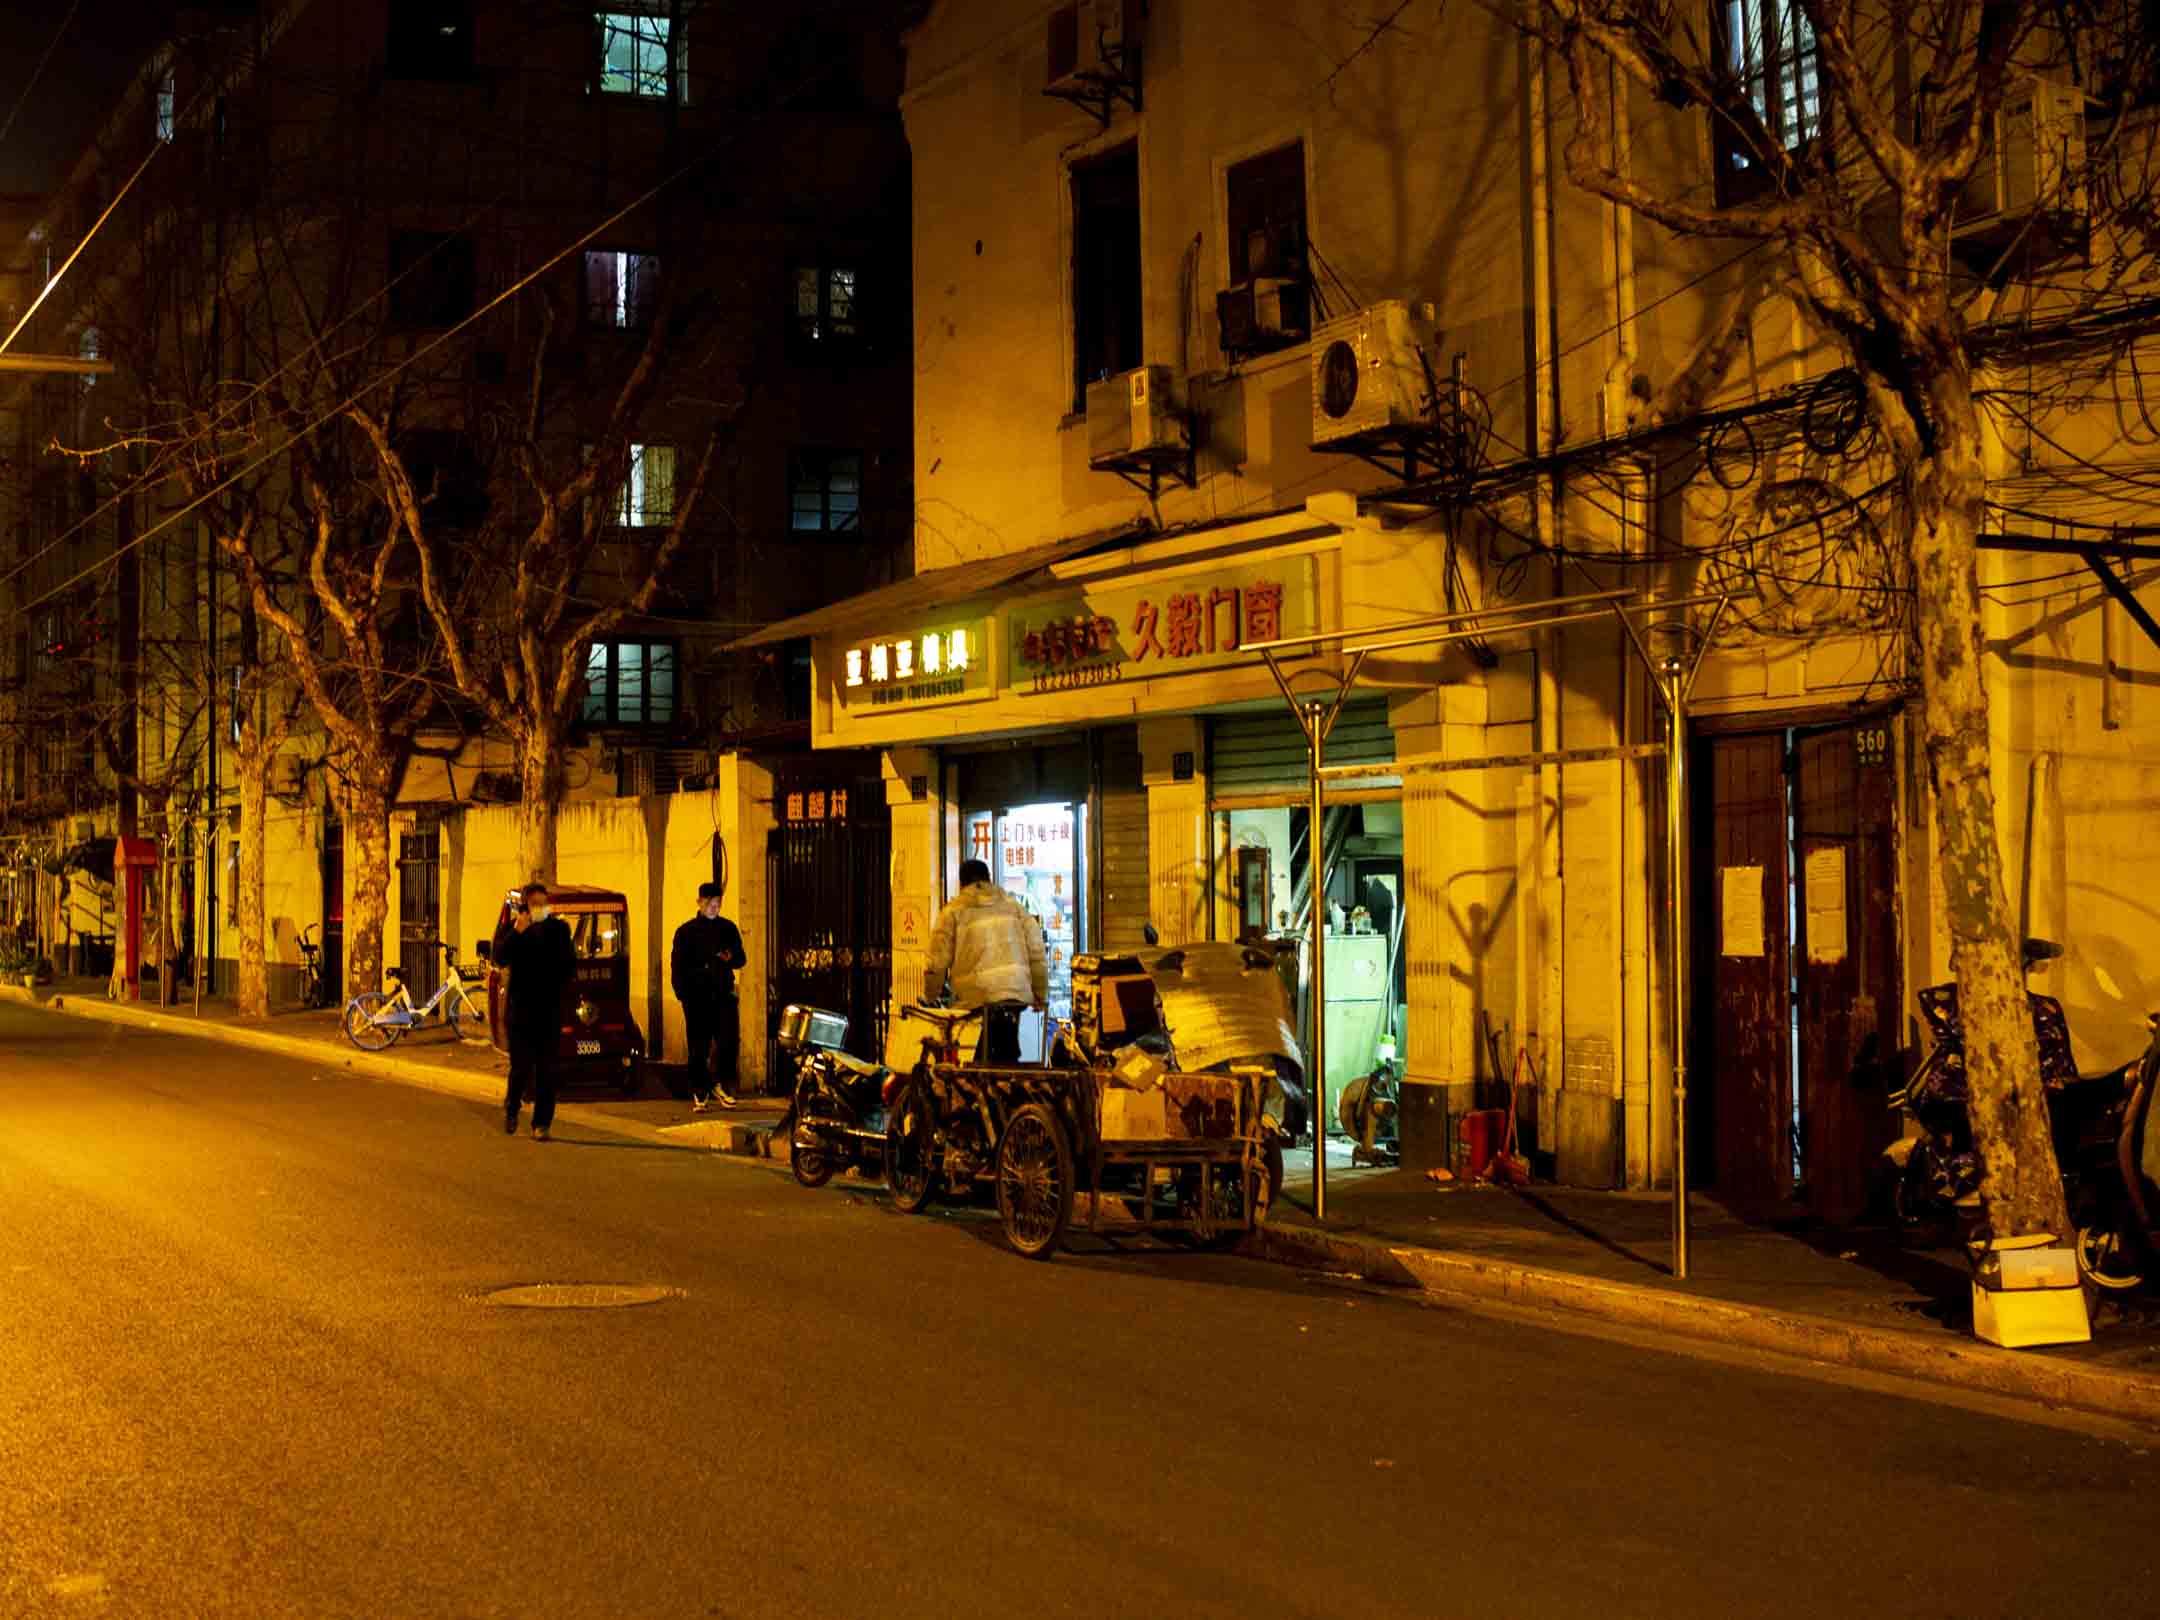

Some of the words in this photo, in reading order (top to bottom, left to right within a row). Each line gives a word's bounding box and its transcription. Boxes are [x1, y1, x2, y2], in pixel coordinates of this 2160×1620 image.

[1131, 580, 1282, 662] 久毅门窗
[1857, 729, 1886, 752] 560
